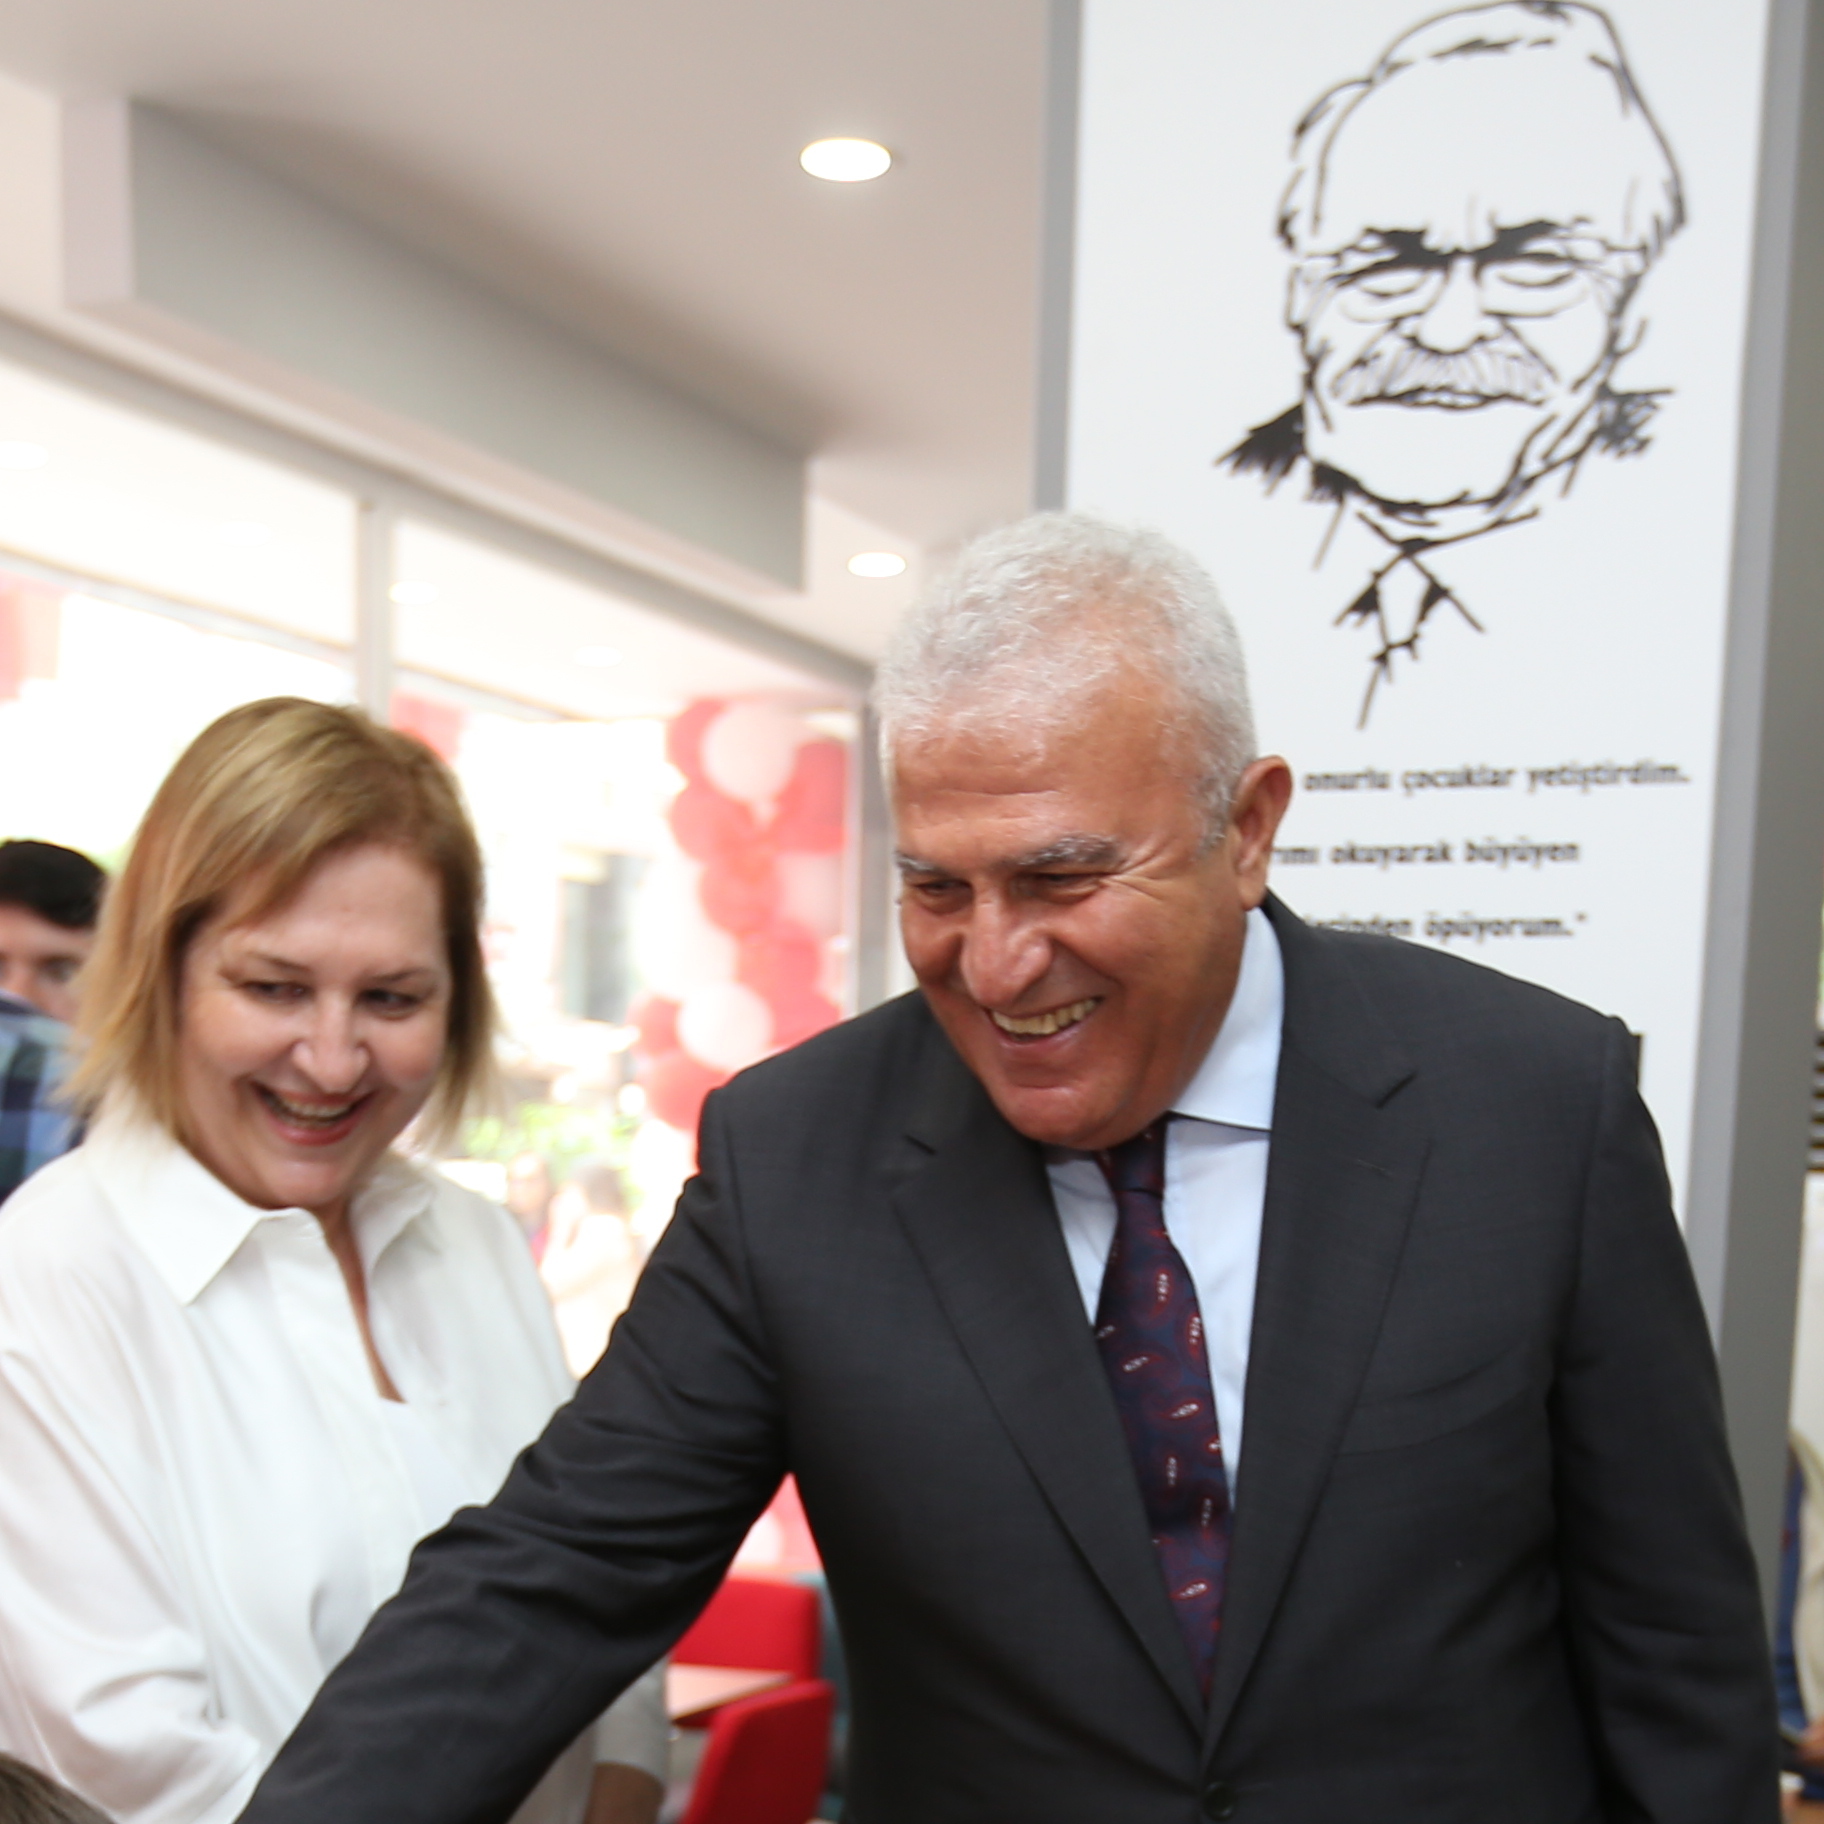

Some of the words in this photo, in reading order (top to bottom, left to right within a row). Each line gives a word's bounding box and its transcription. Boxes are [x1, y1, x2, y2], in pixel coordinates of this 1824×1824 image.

[1304, 766, 1389, 791] onurlu
[1401, 764, 1514, 796] çocuklar
[1527, 760, 1690, 795] yetiştirdim.
[1330, 840, 1452, 870] okuyarak
[1464, 837, 1580, 870] büyüyen
